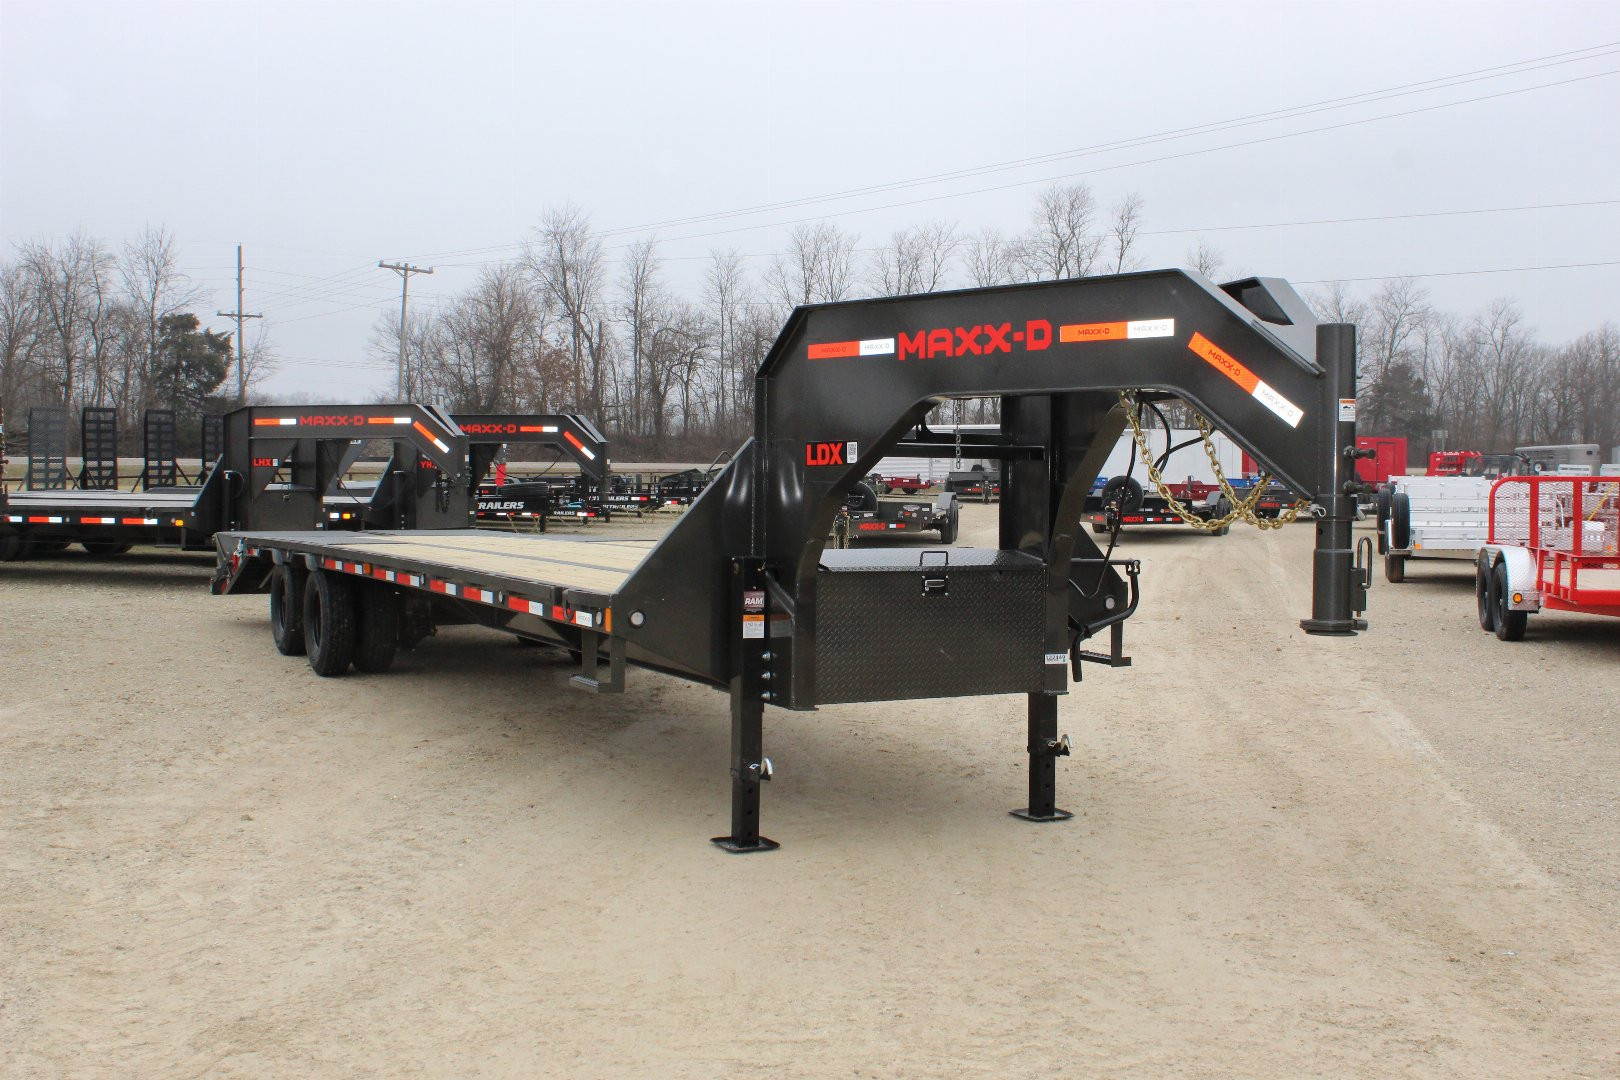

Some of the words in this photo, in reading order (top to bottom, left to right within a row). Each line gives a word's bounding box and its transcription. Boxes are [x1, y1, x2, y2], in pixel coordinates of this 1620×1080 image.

[1077, 327, 1110, 336] MAXX-D
[1133, 324, 1168, 333] MAXX-D
[898, 319, 1052, 360] MAXX-D
[1207, 349, 1241, 377] MAXX-D
[300, 415, 364, 426] MAXX-D
[460, 424, 517, 434] MAXX-D
[806, 442, 843, 466] LDX
[253, 458, 271, 467] LHX
[478, 501, 524, 509] RAILERS
